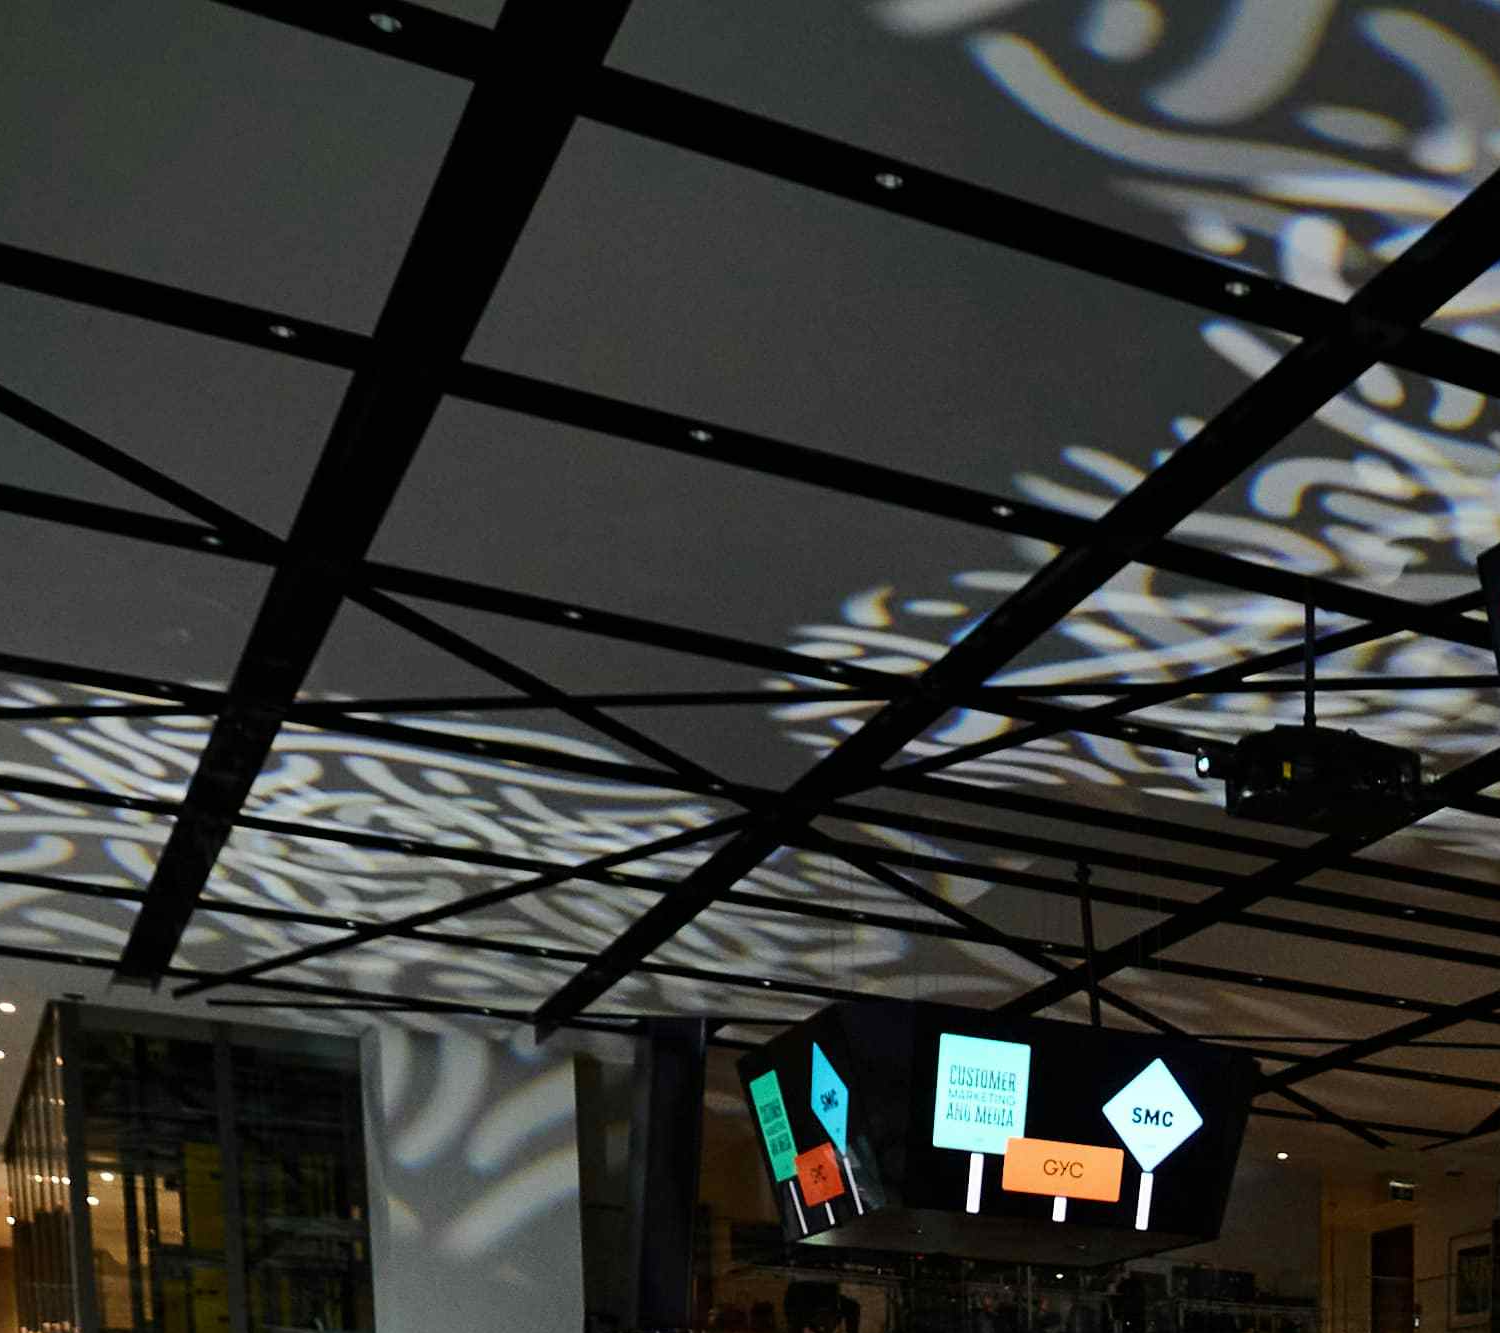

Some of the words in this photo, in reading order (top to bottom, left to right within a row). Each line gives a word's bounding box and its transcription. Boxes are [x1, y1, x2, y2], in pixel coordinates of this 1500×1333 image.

[949, 1064, 1017, 1092] CUSTOMER
[948, 1088, 1016, 1106] MARKETING
[946, 1102, 971, 1122] AND
[974, 1105, 1014, 1127] MEDIA
[1131, 1106, 1174, 1128] SMC
[1043, 1159, 1084, 1179] GYC
